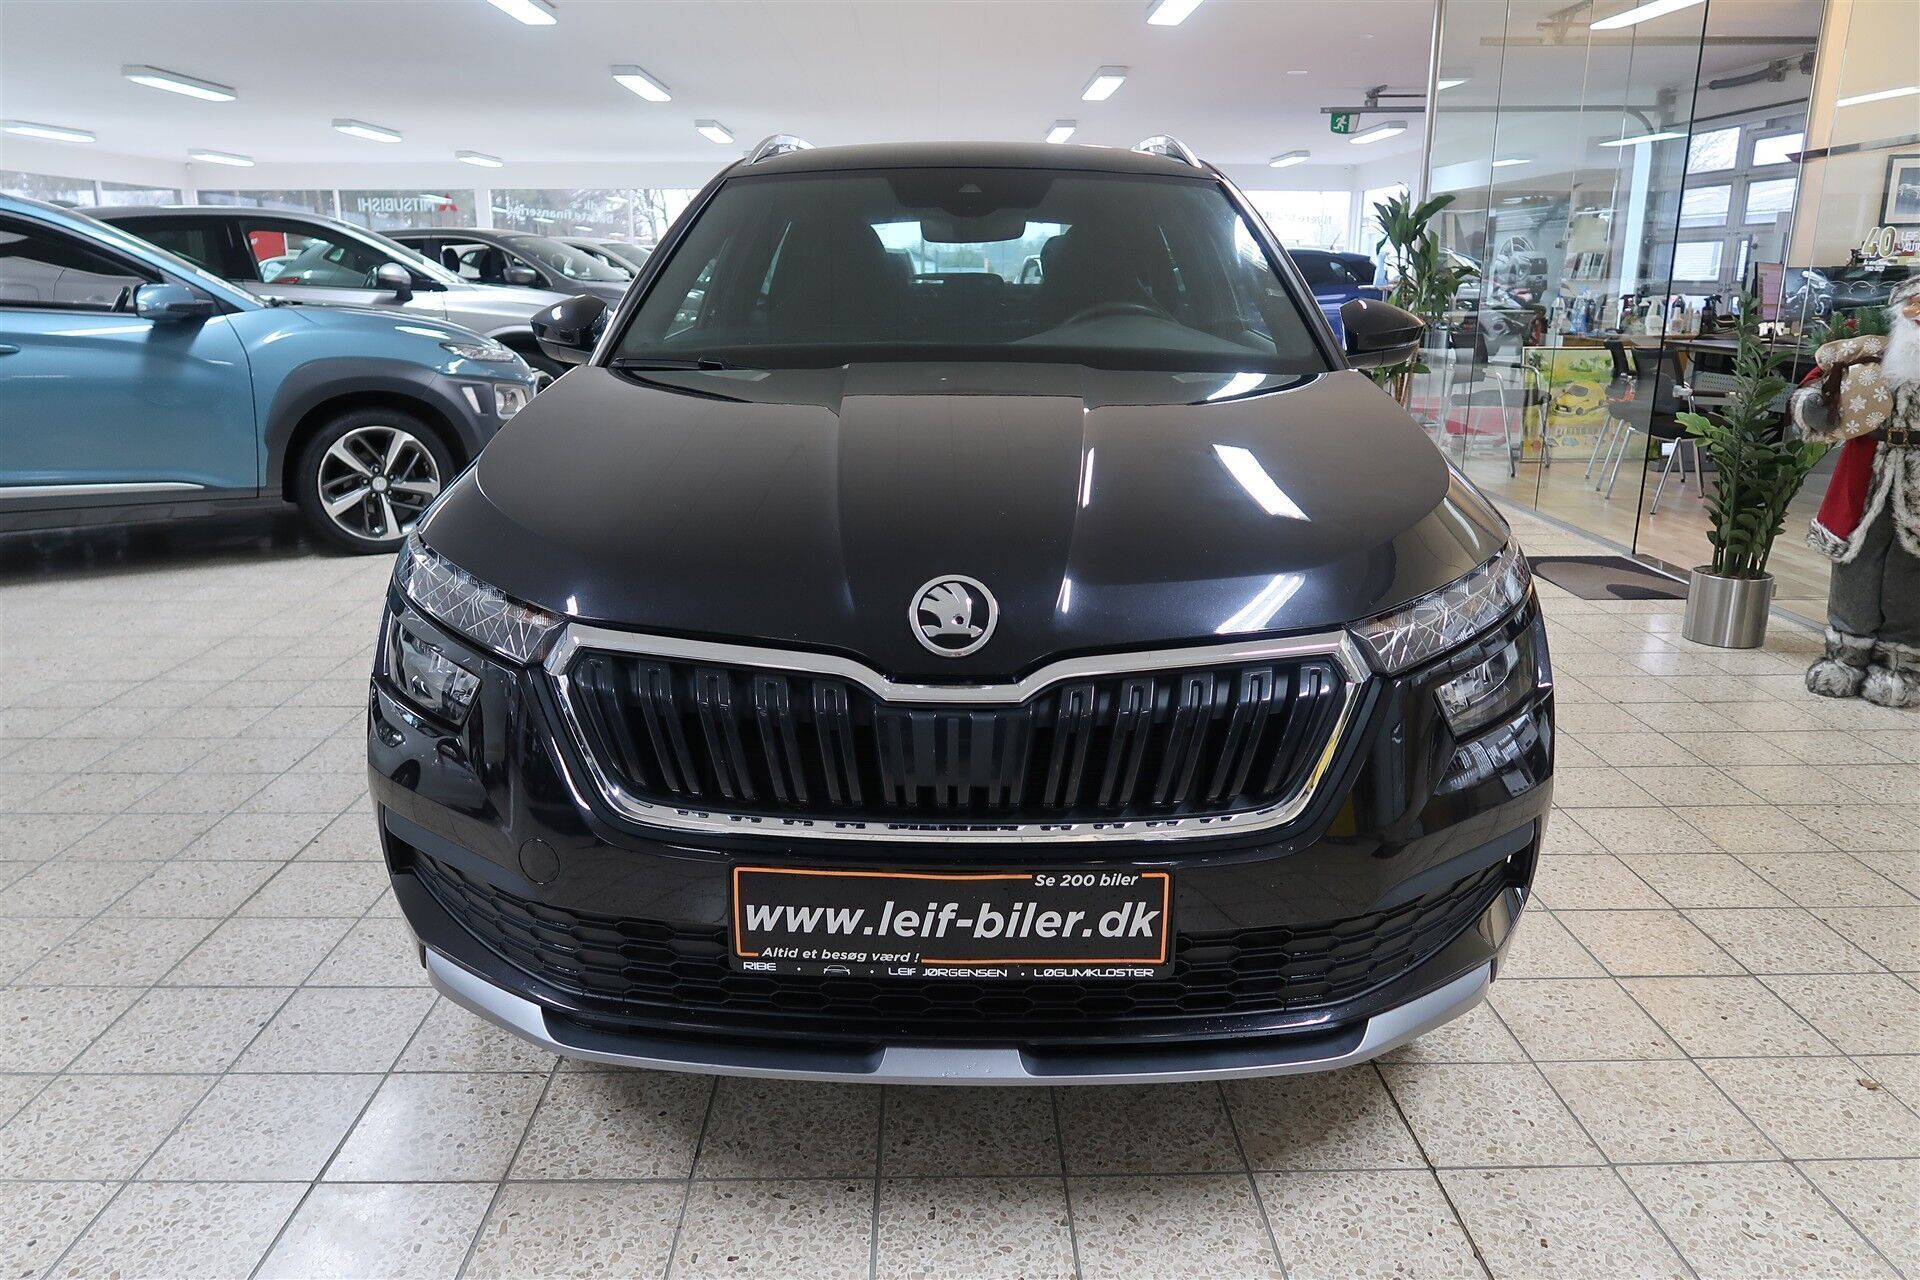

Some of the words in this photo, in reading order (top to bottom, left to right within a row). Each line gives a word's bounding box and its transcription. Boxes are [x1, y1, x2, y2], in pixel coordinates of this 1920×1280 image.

[1861, 226, 1897, 258] 40
[1034, 874, 1056, 887] Se
[1060, 874, 1095, 887] 200
[1099, 873, 1139, 886] biler
[746, 900, 1160, 938] www.leif-biler.dk
[761, 946, 798, 958] Altid
[802, 949, 818, 959] et
[821, 949, 867, 962] besøg
[871, 951, 911, 963] værd
[743, 961, 777, 971] RIBE
[888, 966, 917, 976] LEIF
[922, 967, 1008, 977] JØRGENSEN
[1033, 967, 1155, 978] LØGUMKLOSTER
